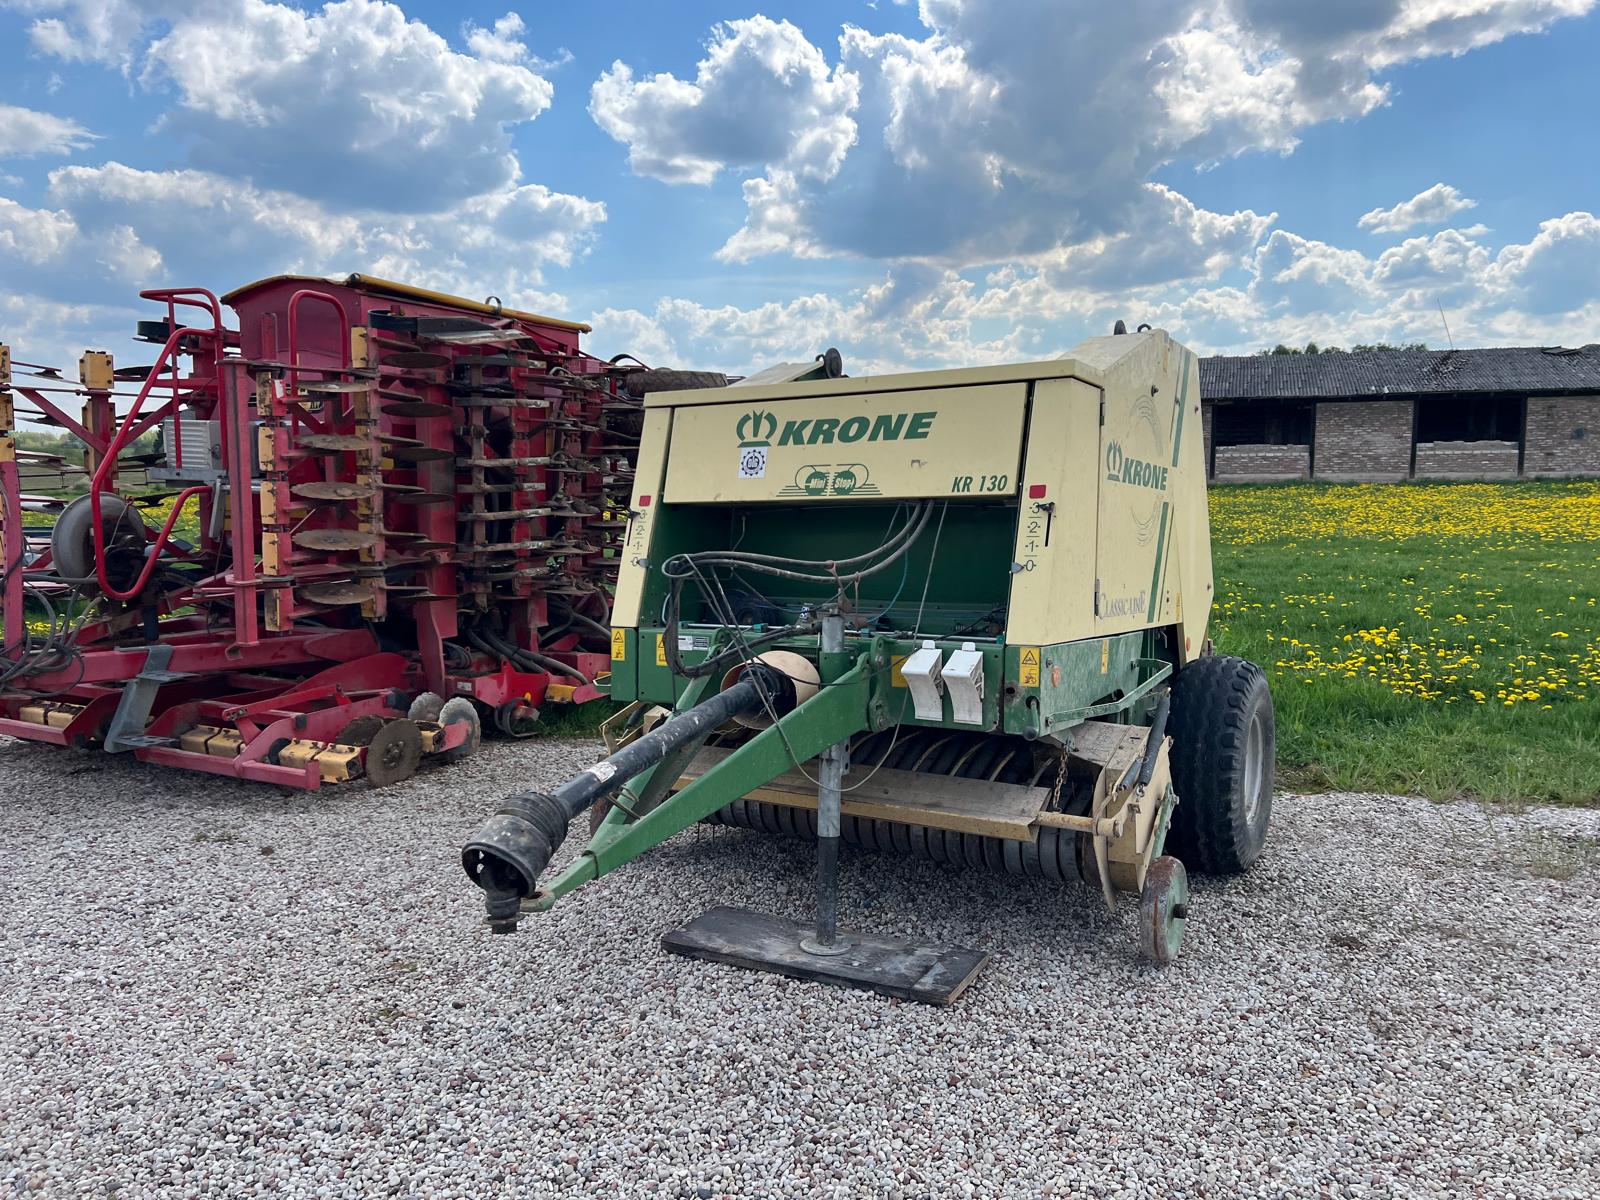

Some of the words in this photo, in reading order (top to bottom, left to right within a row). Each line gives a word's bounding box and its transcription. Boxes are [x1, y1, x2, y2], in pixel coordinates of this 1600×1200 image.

[777, 411, 938, 447] KRONE
[809, 478, 827, 489] Mini
[951, 476, 973, 493] KR
[979, 475, 1008, 493] 130
[1122, 457, 1168, 491] KRONE
